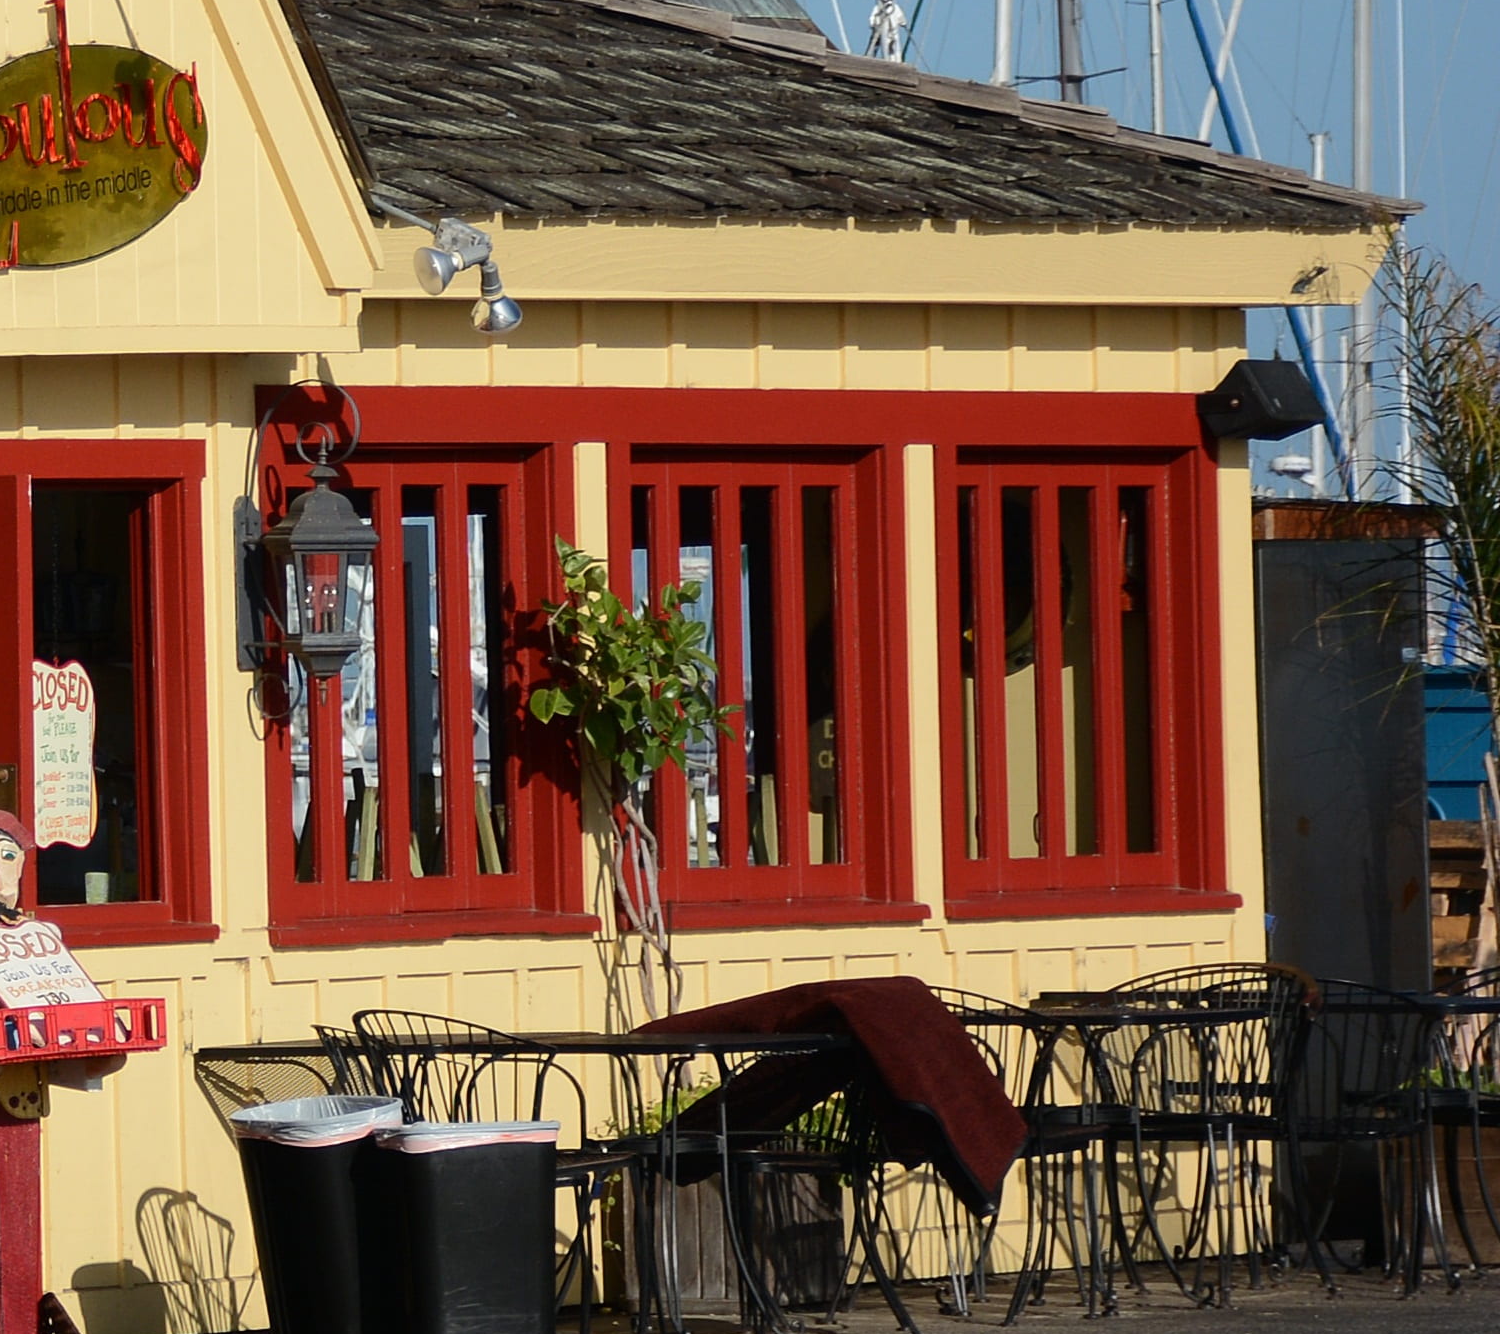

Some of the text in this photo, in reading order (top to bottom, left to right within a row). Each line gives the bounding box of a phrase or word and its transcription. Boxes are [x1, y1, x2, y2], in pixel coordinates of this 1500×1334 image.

[46, 182, 61, 206] in
[63, 178, 90, 204] the
[95, 167, 152, 197] middle
[0, 969, 30, 983] Join
[6, 977, 88, 998] BREAKFAST
